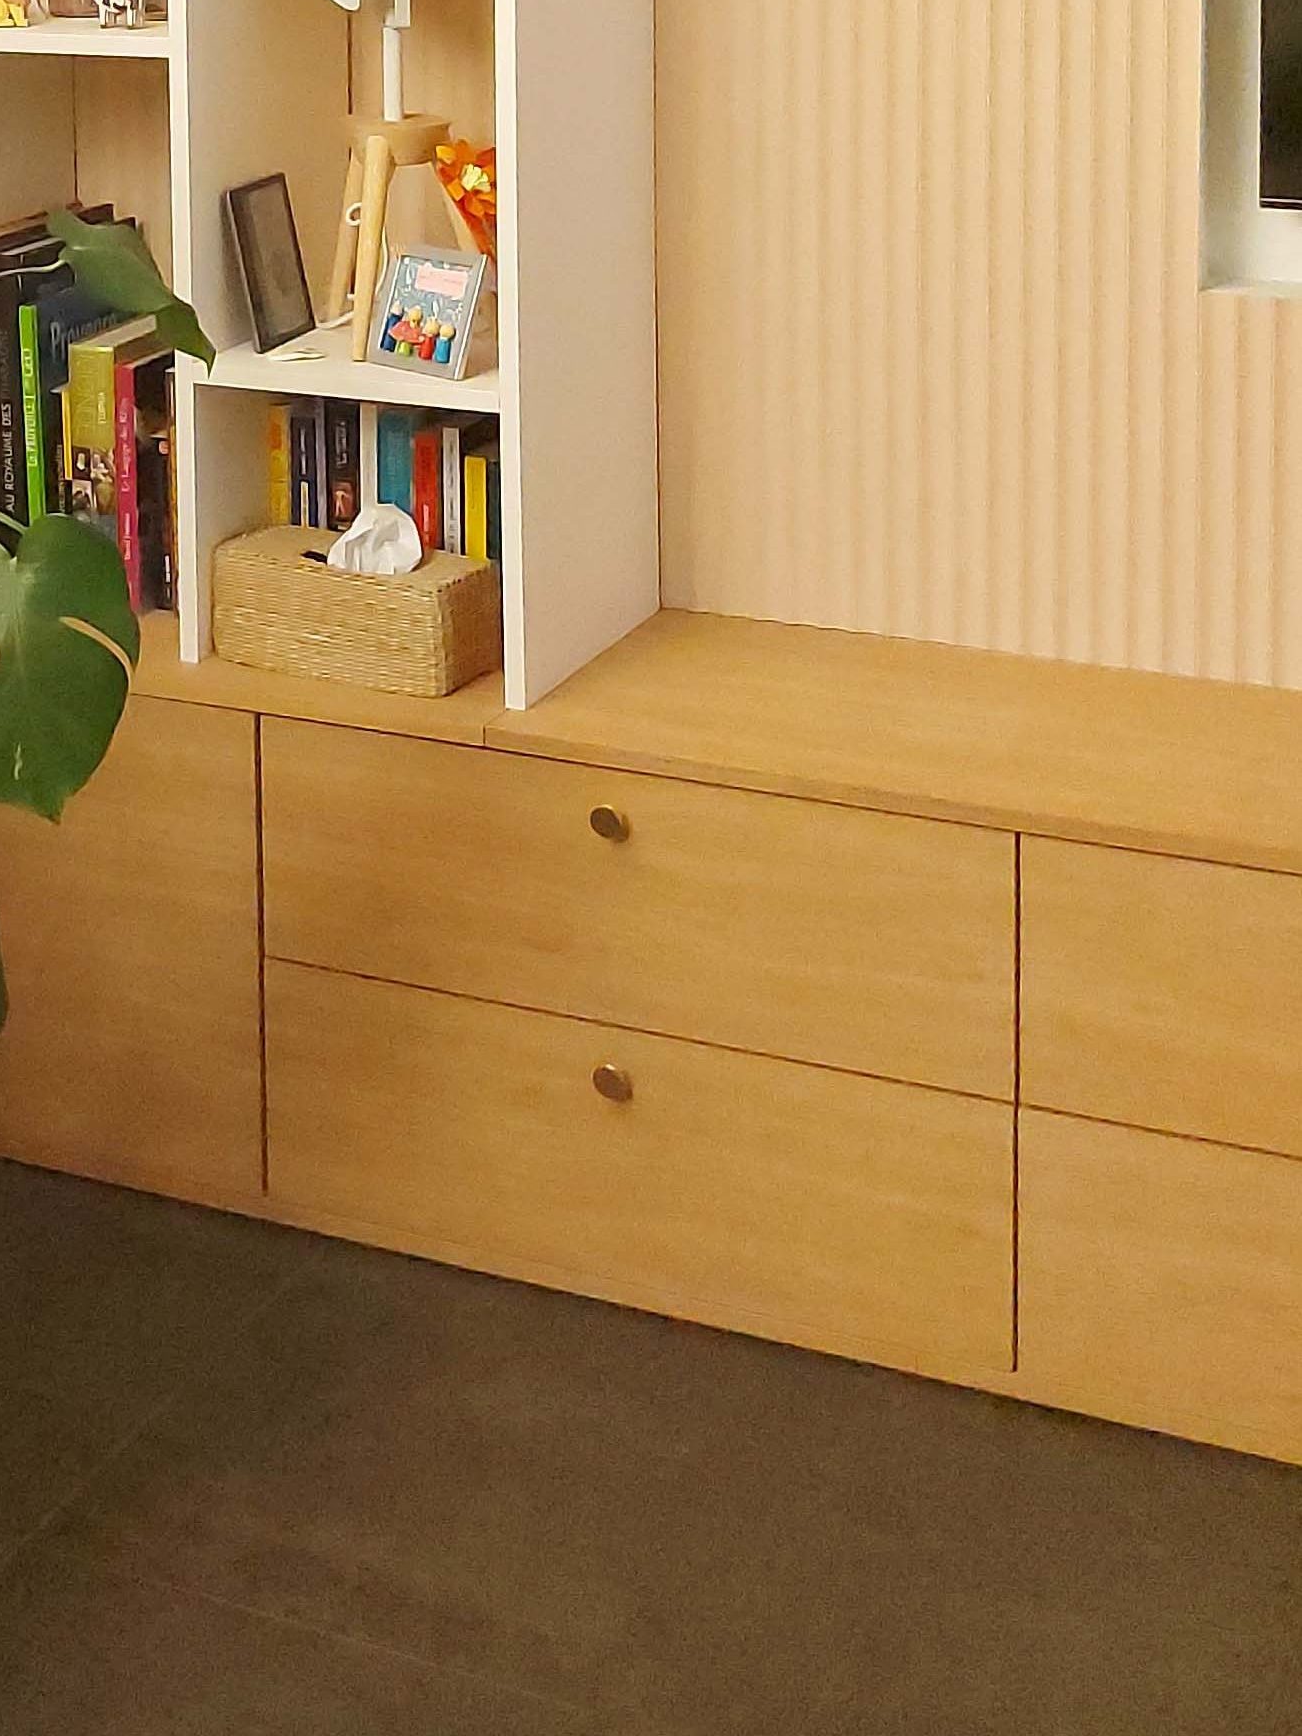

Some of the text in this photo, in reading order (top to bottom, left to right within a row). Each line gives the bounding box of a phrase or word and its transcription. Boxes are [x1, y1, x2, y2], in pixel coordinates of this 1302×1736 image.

[1, 404, 11, 426] DES
[1, 432, 14, 490] ROYAUME
[5, 494, 15, 512] AU
